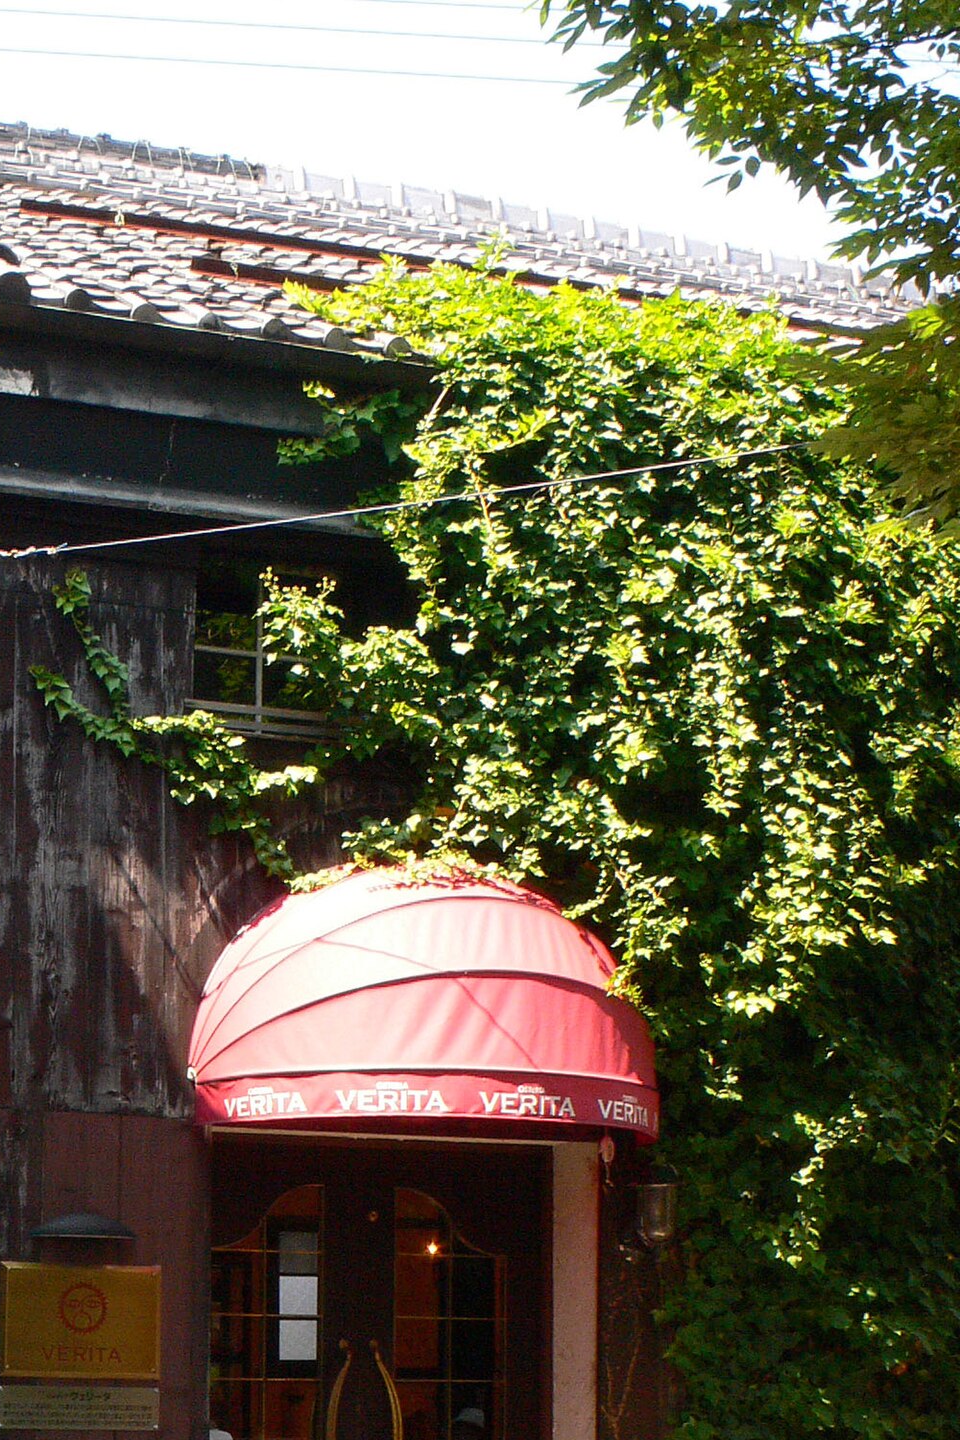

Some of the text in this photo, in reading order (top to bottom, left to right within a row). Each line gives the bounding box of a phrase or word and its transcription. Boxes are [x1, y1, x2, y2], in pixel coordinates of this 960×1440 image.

[224, 1091, 308, 1118] VERITA
[335, 1089, 448, 1112] VERITA
[479, 1091, 576, 1117] VERITA
[597, 1098, 649, 1127] VERITA
[42, 1347, 122, 1363] VERITA
